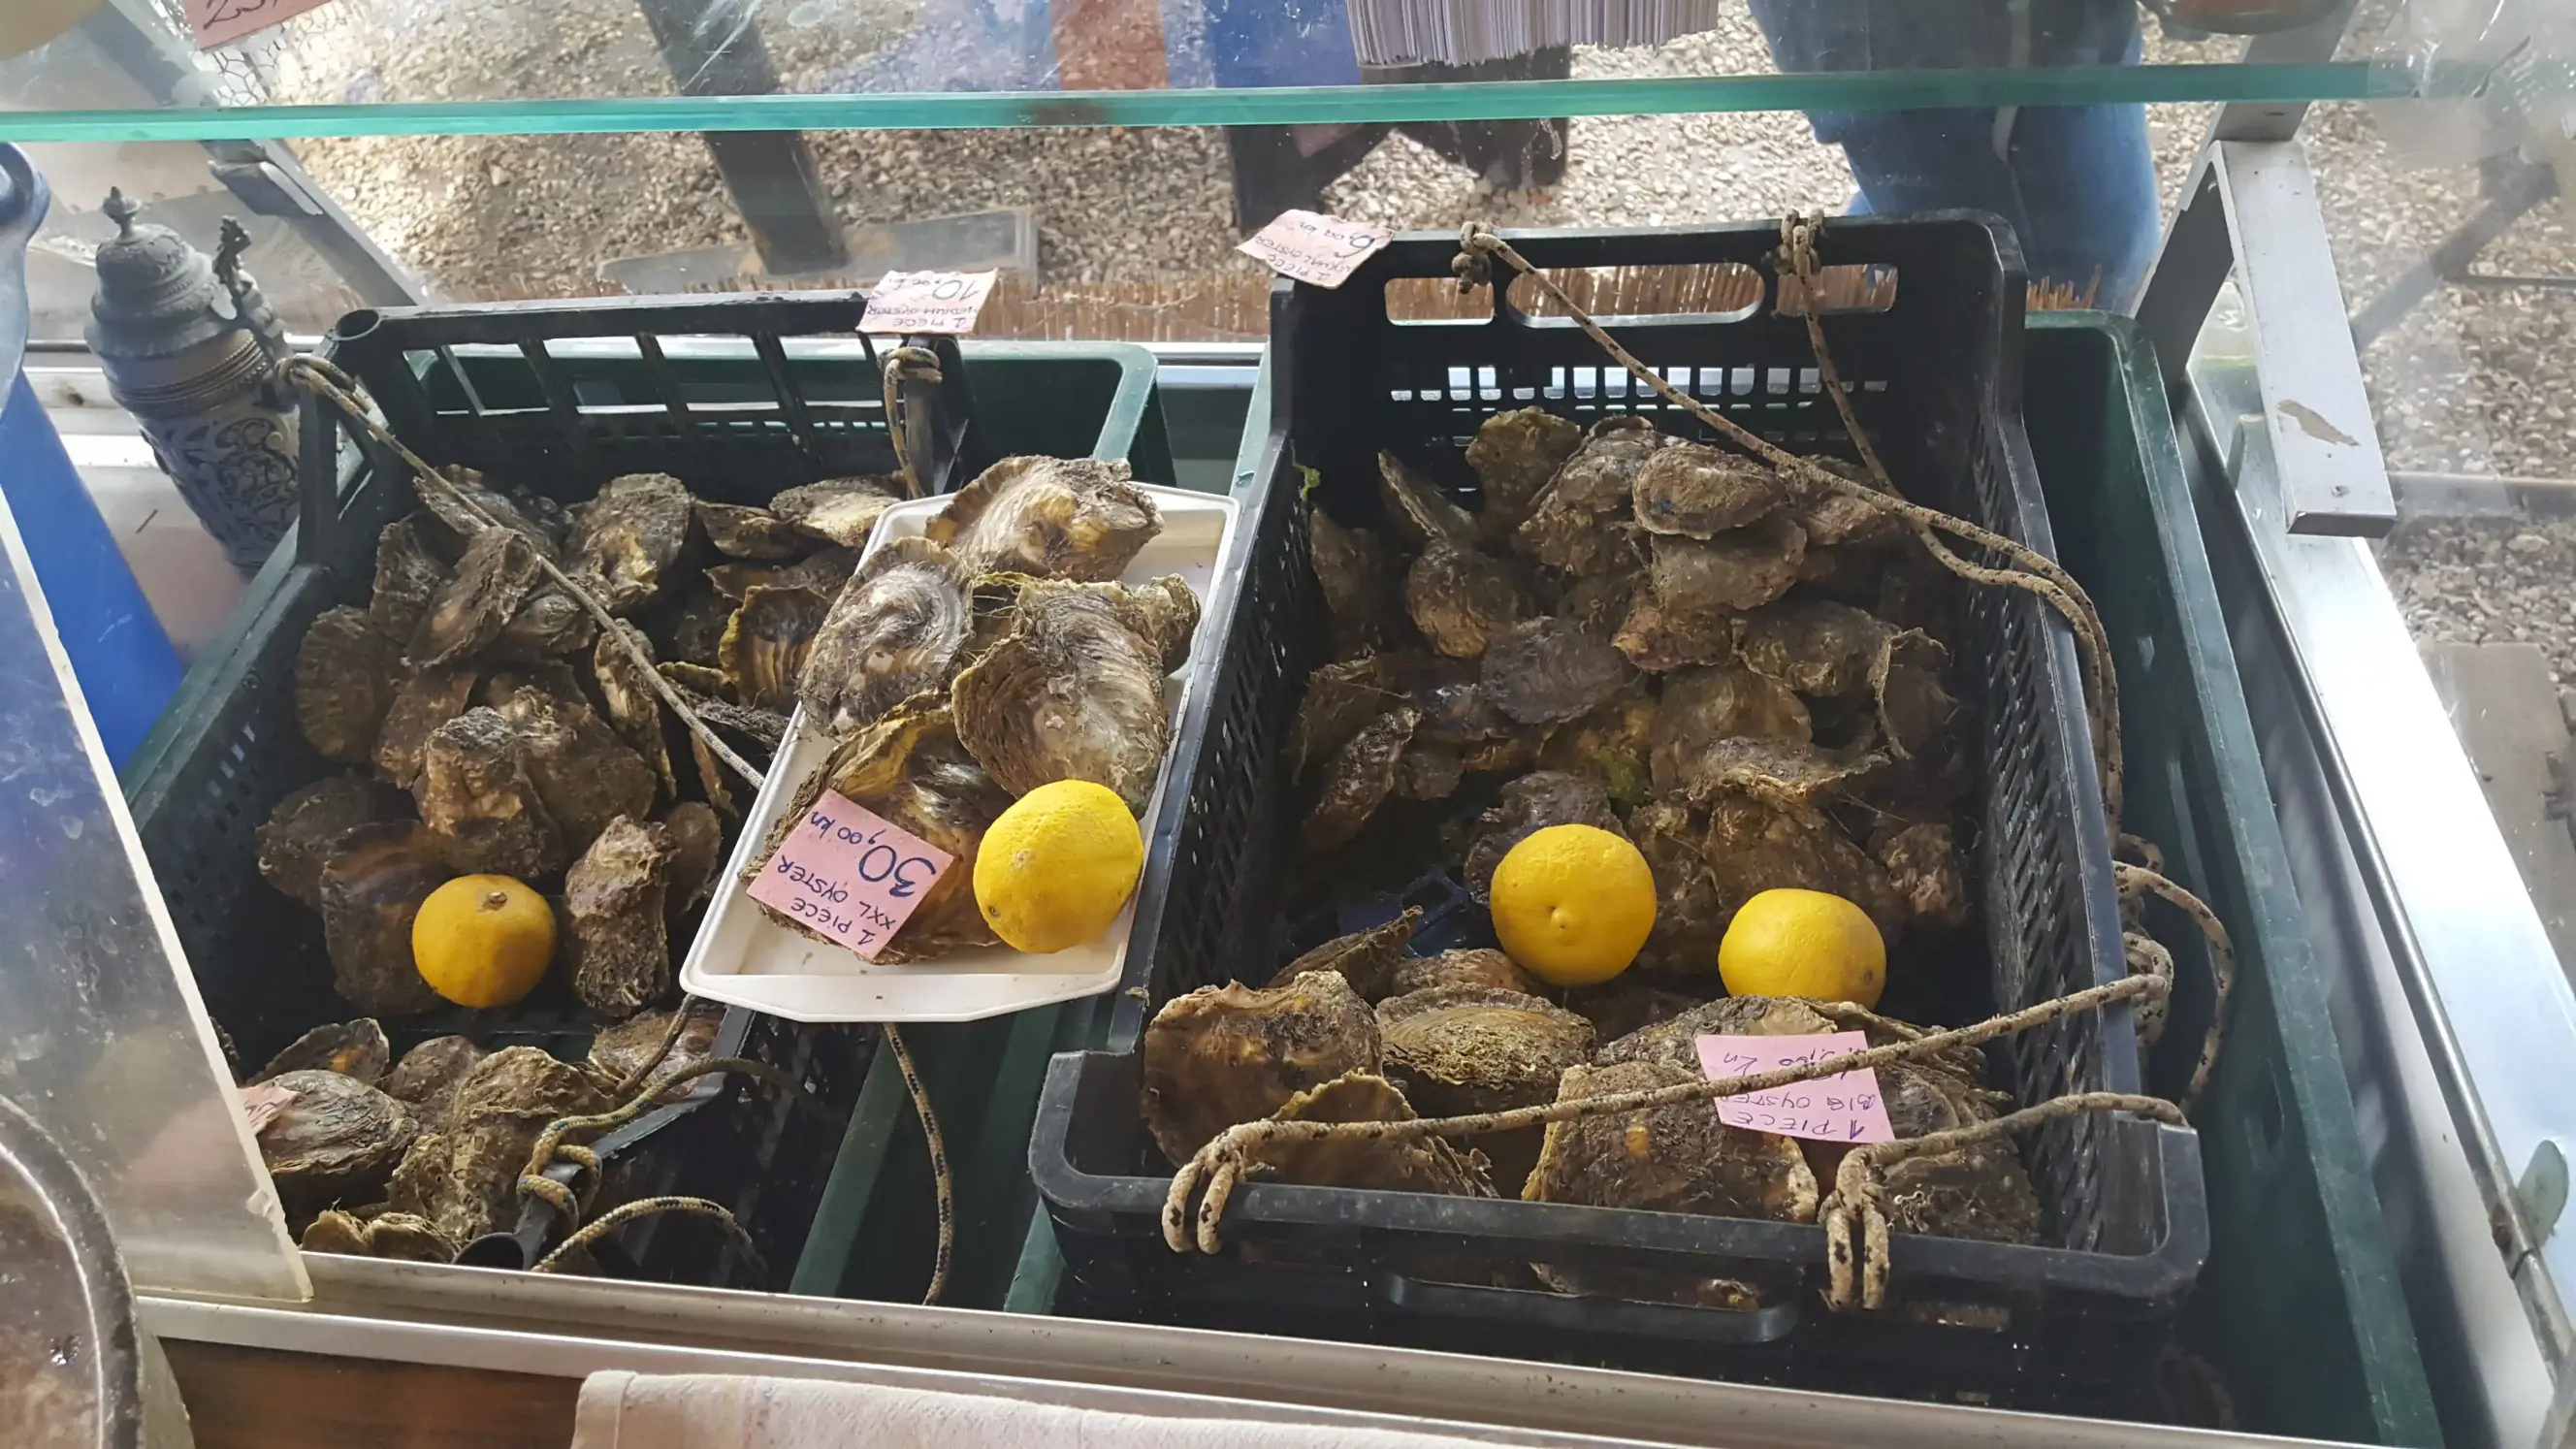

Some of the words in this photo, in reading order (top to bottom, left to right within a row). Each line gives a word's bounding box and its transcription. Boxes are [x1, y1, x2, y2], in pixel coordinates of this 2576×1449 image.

[1253, 235, 1304, 258] OYSTER
[1267, 253, 1310, 278] PIECE
[1303, 254, 1353, 274] NORMAL
[891, 317, 946, 328] PIECE
[952, 316, 967, 329] 1
[809, 811, 836, 841] kn
[836, 825, 938, 898] 30,00
[776, 853, 849, 905] OYSTER
[789, 896, 853, 935] PIECE
[858, 900, 897, 931] XXL
[856, 928, 876, 947] 1
[1825, 1092, 1877, 1112] BIG
[1730, 1111, 1838, 1137] PIECE
[1849, 1117, 1866, 1142] 1
